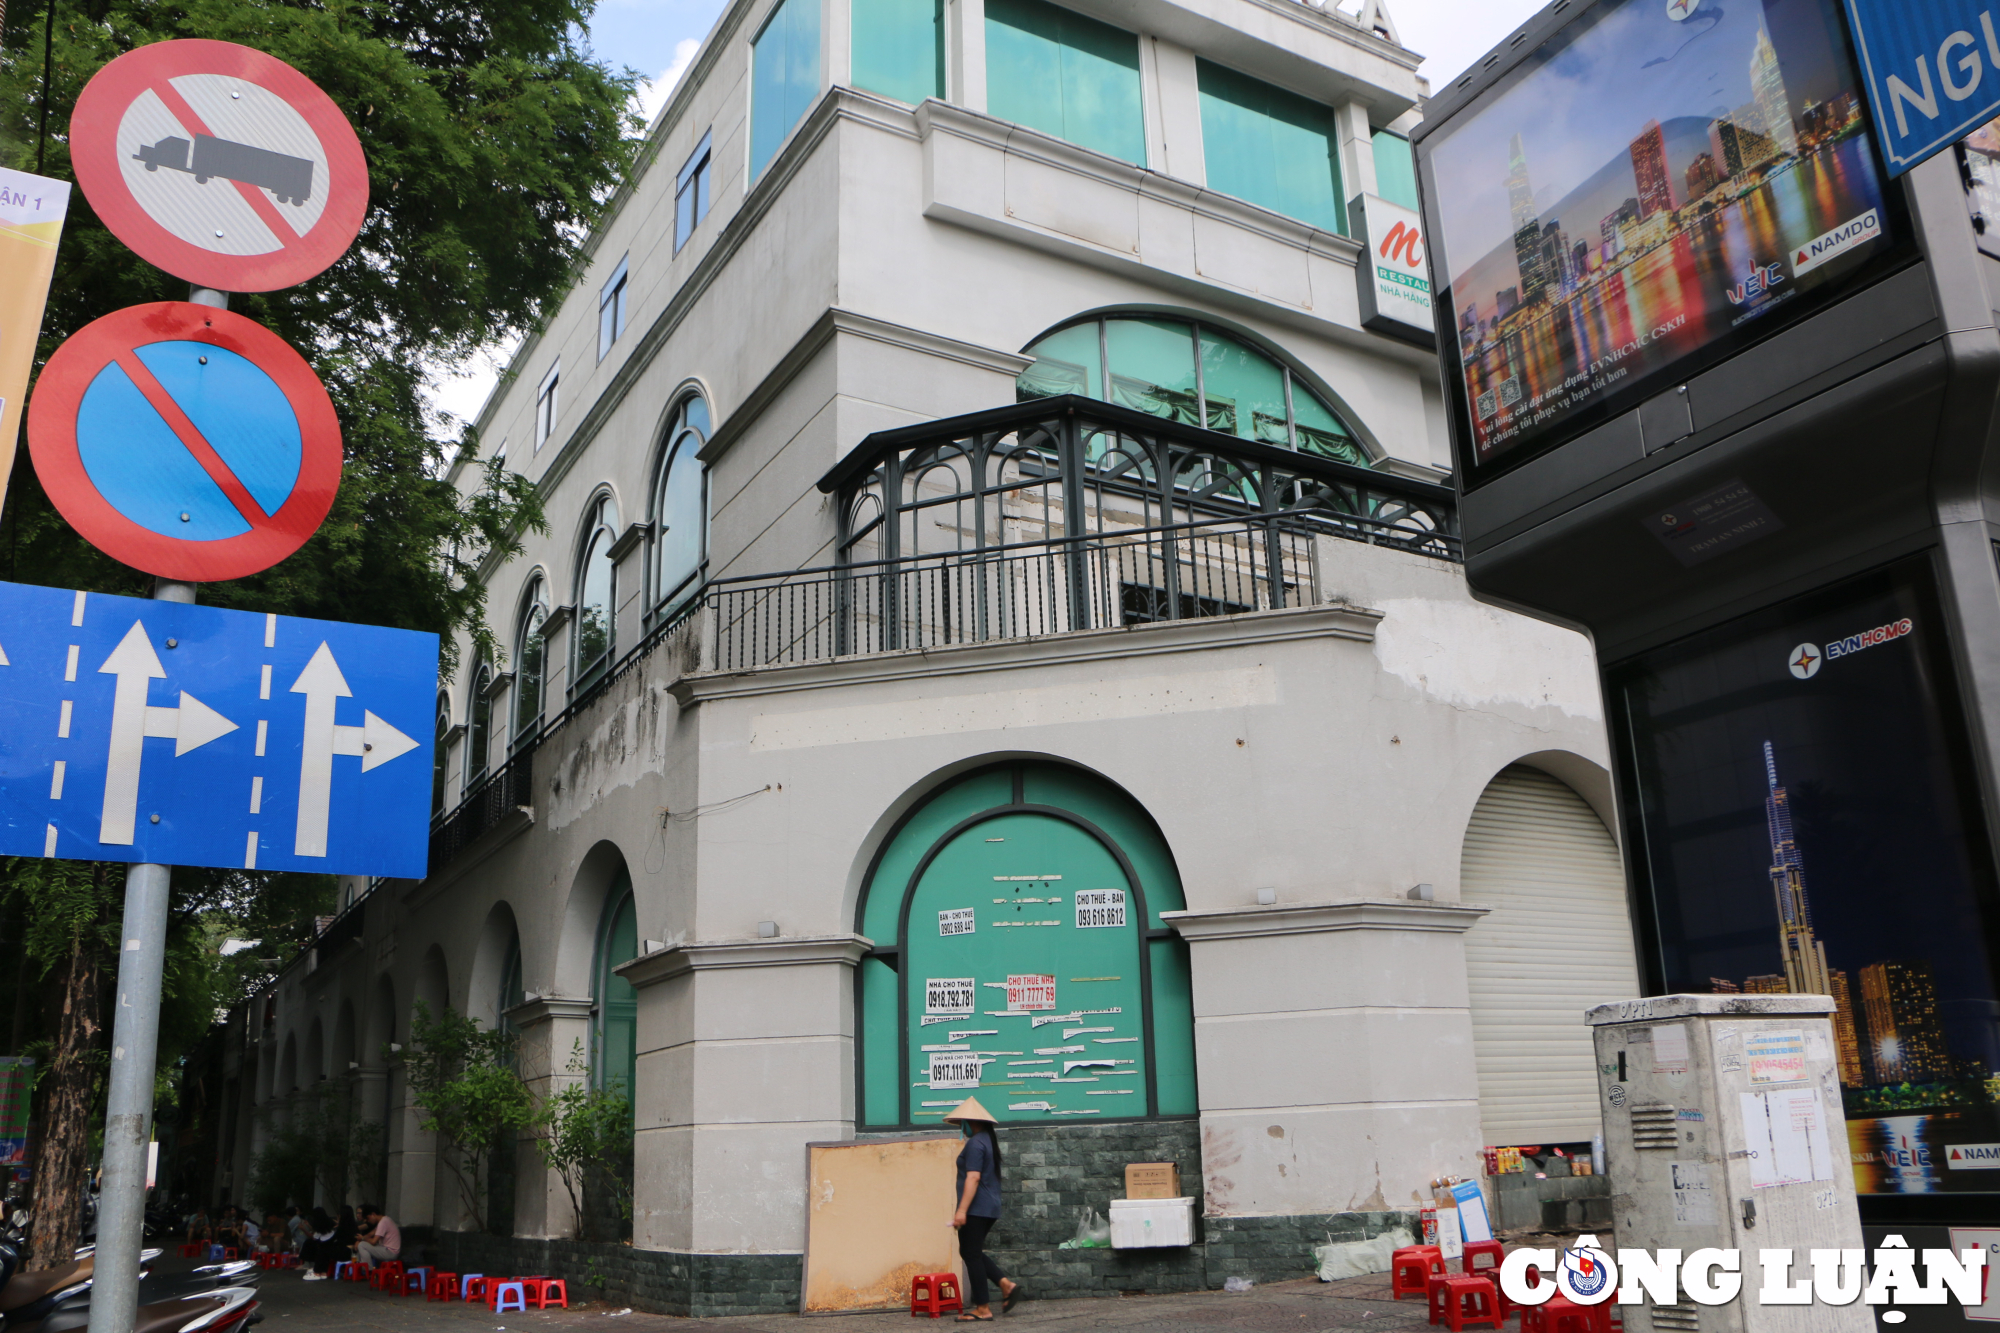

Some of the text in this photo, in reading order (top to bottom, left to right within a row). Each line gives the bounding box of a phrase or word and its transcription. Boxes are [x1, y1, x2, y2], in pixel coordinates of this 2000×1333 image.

[34, 197, 42, 211] 1
[1811, 214, 1876, 256] NAMDO
[1852, 228, 1879, 246] GROUP
[1380, 283, 1430, 308] NHÀ HÀNG
[1480, 313, 1686, 436] Vui lòng cài đặt ứng dụng EVNHCMC CSKH
[1481, 365, 1628, 451] để chúng tôi phục vụ bạn tốt hơn
[1692, 503, 1712, 516] 1900
[1714, 497, 1726, 507] 54
[1725, 492, 1737, 502] 54
[1736, 487, 1749, 497] 54
[1718, 531, 1732, 542] AN
[1732, 520, 1758, 535] NINH
[1826, 618, 1912, 660] EVNHCMC
[1077, 894, 1089, 905] CHO
[1091, 891, 1106, 904] THUÊ
[1112, 891, 1124, 903] BÁN
[1079, 908, 1124, 926] 093 616 8612
[957, 979, 973, 988] THUÊ
[1008, 977, 1021, 985] CHO
[1023, 974, 1039, 985] THUÊ
[928, 990, 973, 1008] 0918.792.781
[1008, 987, 1054, 1002] 0911 7777 69
[933, 1063, 978, 1081] 0917.111.661
[1427, 1222, 1436, 1246] Tiger
